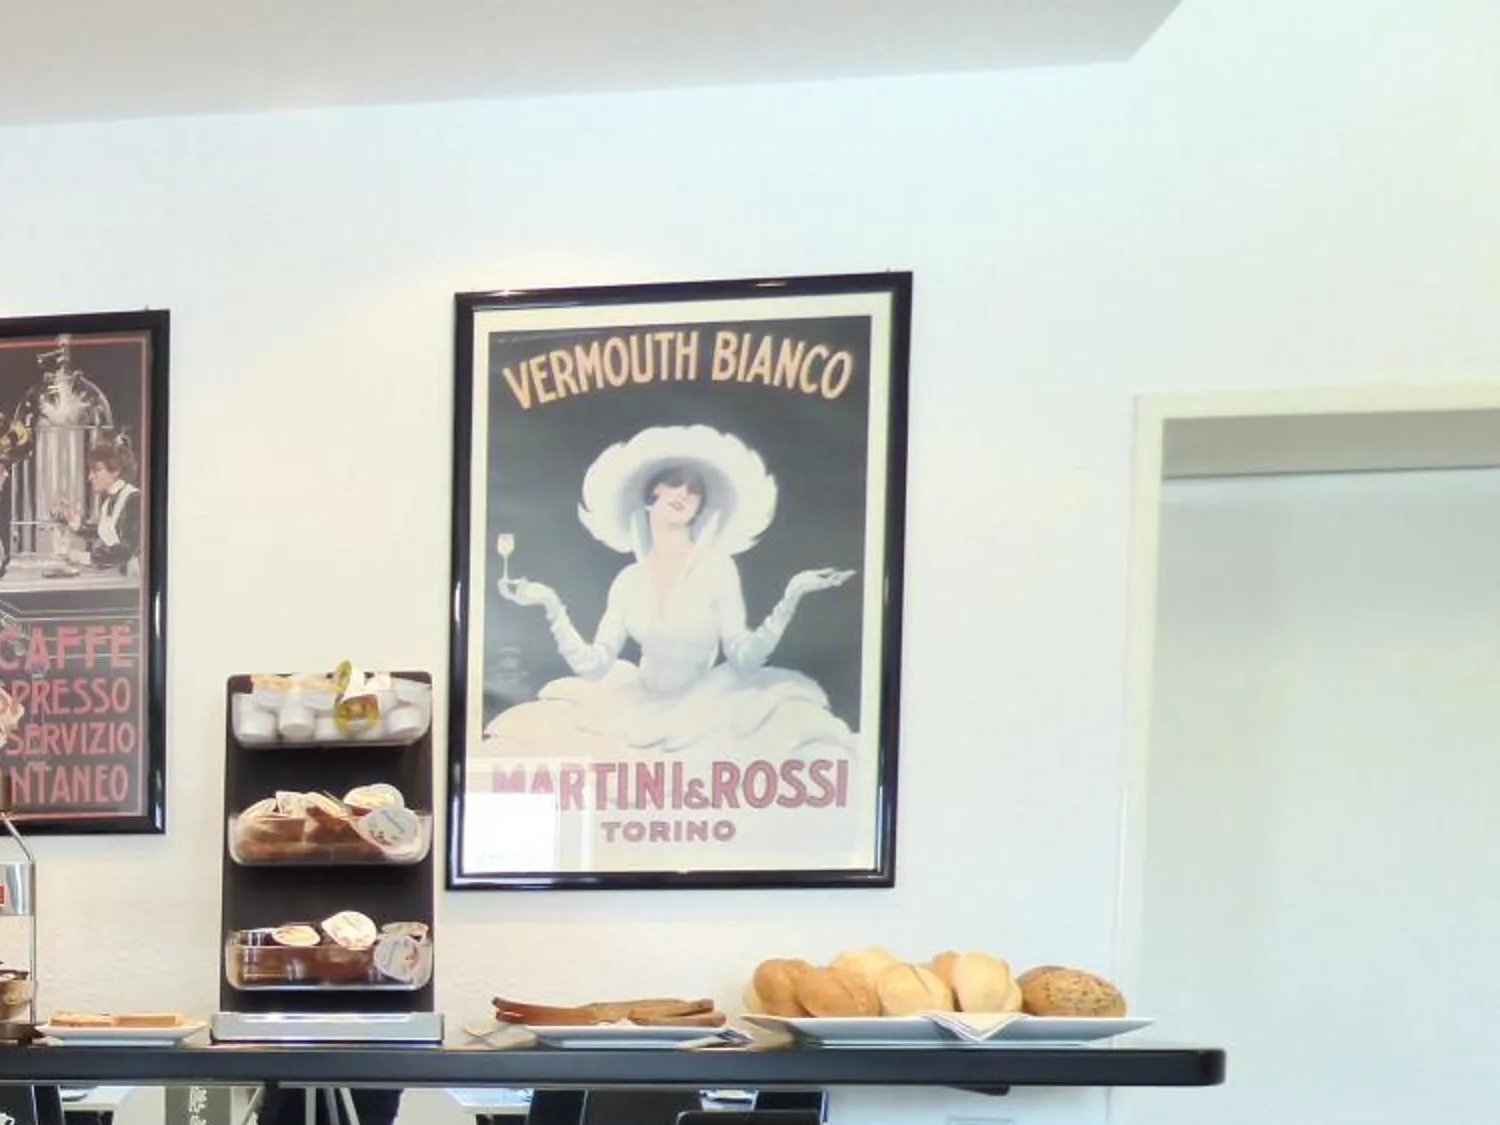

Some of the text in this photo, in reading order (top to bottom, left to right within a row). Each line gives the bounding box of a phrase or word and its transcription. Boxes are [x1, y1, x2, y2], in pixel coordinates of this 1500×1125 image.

[503, 330, 853, 410] VERMOUTH BIANCO
[5, 721, 136, 756] SERVIZIO
[600, 820, 738, 843] TORINO
